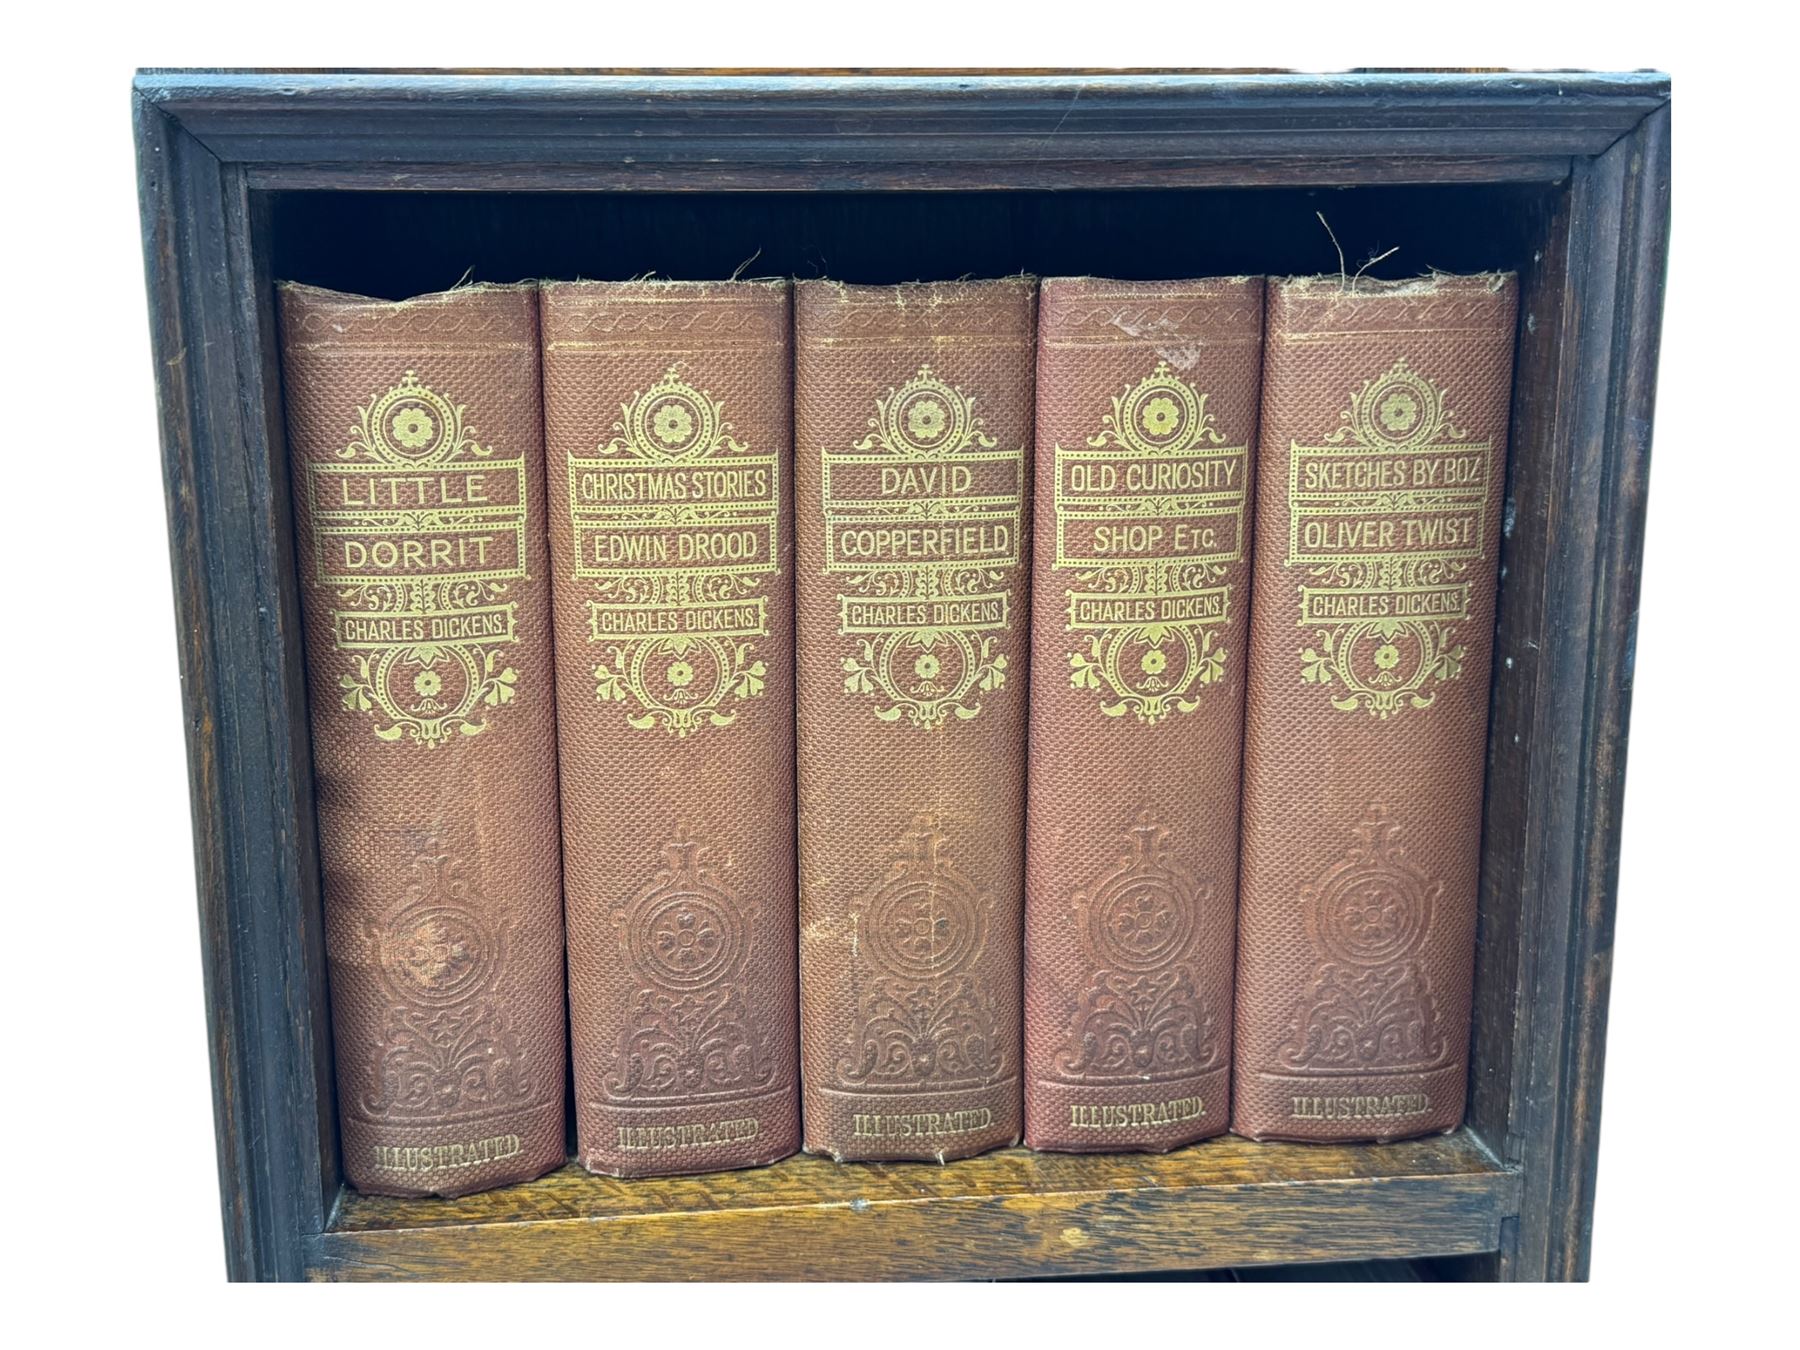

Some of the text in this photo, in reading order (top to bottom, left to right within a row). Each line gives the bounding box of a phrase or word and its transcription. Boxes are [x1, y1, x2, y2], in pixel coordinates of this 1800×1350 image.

[582, 469, 767, 500] CHRISTMAS STORIES
[881, 465, 972, 495] DAVID
[1071, 459, 1237, 492] OLD CURIOSITY
[1305, 457, 1481, 489] SKETCHES BY BOZ
[341, 475, 488, 505] LITTLE
[594, 531, 757, 562] EDWIN DROOD
[840, 525, 1009, 556] COPPERFIELD
[1093, 525, 1163, 552] SHOP
[1304, 517, 1474, 549] OLIVER TWIST
[344, 536, 493, 568] DORRIT
[852, 601, 1001, 626] CHARLES DICKENS.
[1080, 596, 1222, 621] CHARLES DICKENS.
[1312, 591, 1460, 617] CHARLES DICKENS.
[345, 614, 506, 640] CHARLES DICKENS.
[602, 607, 757, 632] CHARLES DICKENS.
